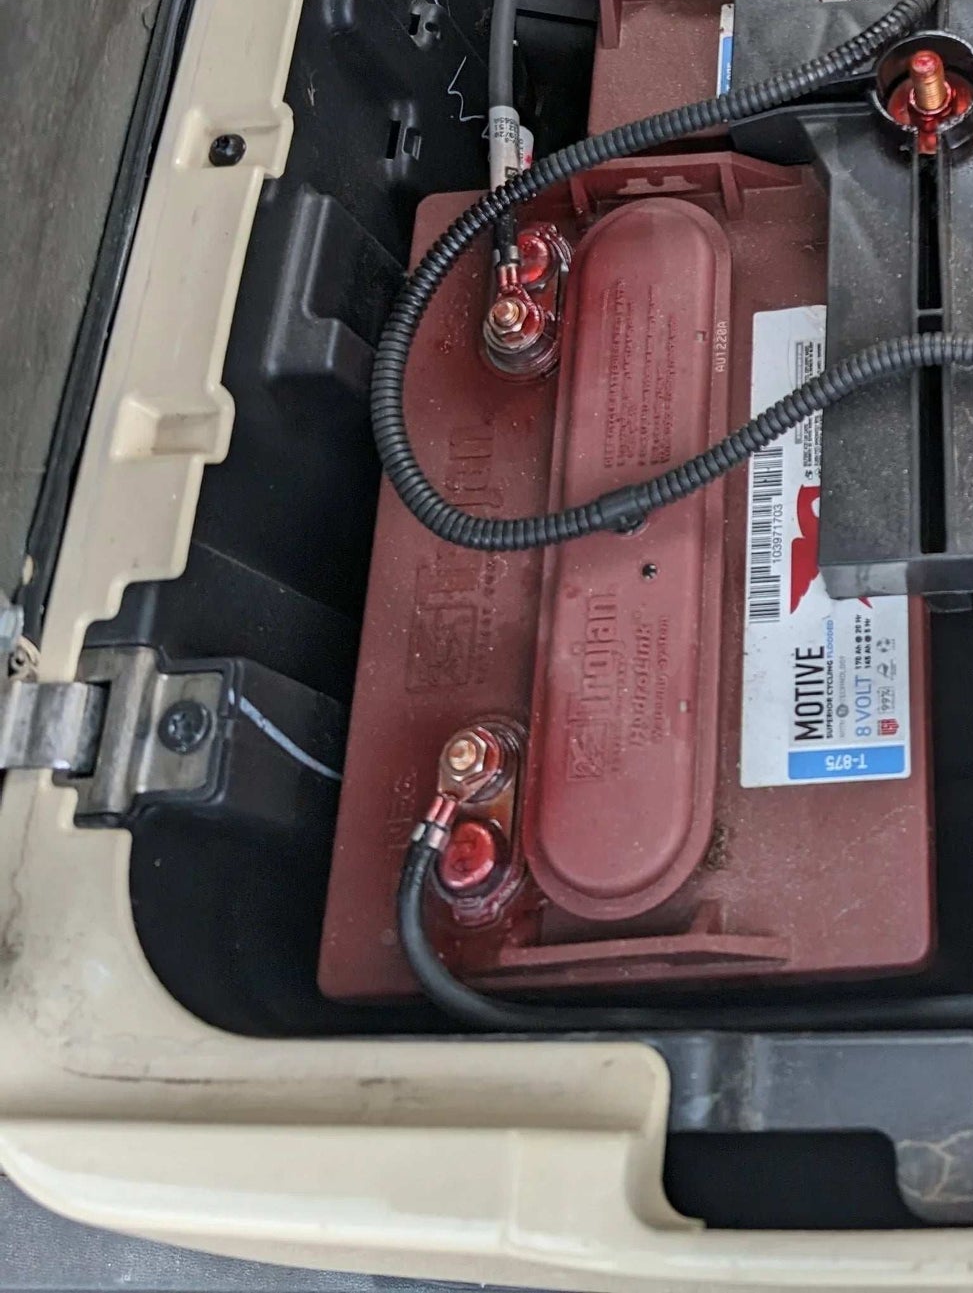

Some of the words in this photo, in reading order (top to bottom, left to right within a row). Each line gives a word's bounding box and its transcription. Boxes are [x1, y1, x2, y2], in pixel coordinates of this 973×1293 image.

[716, 321, 728, 373] AU1220A
[772, 503, 784, 563] 103971703
[825, 619, 834, 658] FLOODED
[855, 624, 861, 633] 20
[571, 593, 627, 722] Trojan
[855, 644, 861, 653] Ah
[864, 644, 871, 653] Ah
[792, 646, 825, 740] MOTIVE
[825, 659, 833, 695] CYCLING
[825, 696, 834, 738] SUPERIOR
[854, 674, 872, 722] VOLT
[855, 725, 871, 736] 8
[825, 753, 868, 771] T-875
